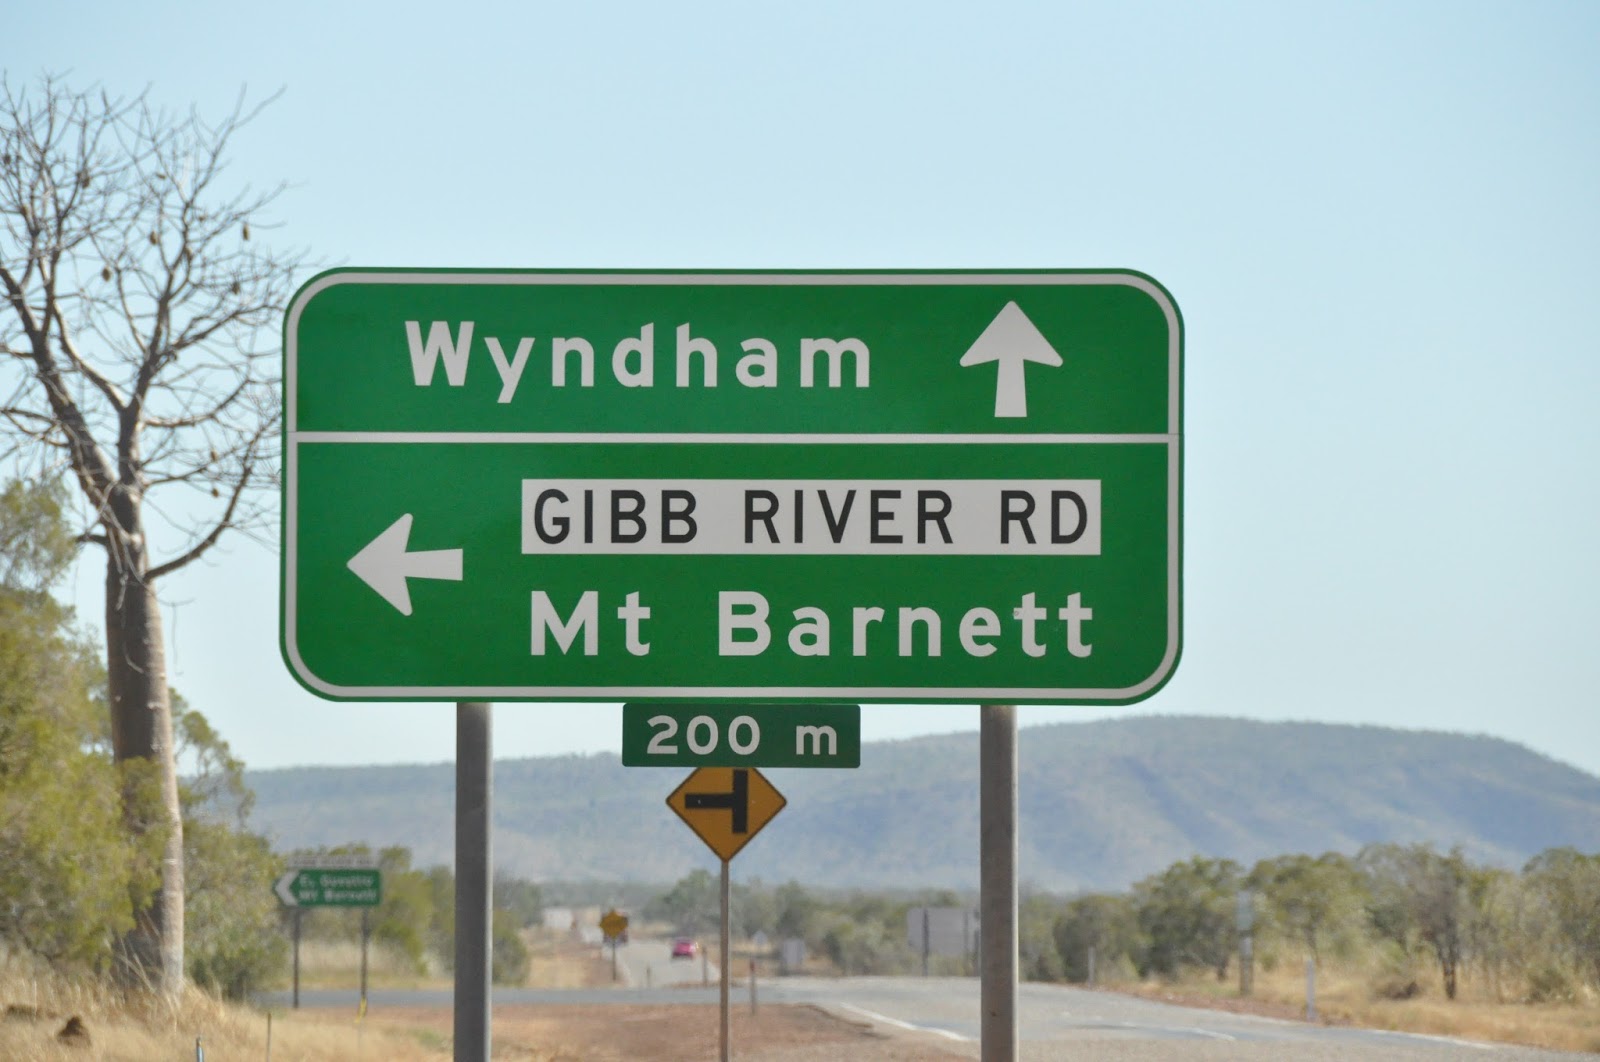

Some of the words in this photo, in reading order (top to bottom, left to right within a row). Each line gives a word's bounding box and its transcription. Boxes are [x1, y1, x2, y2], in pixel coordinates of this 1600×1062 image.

[405, 320, 870, 404] Wyndham
[534, 488, 698, 545] GIBB
[744, 489, 954, 544] RIVER
[1000, 489, 1088, 545] RD
[530, 590, 651, 657] Mt
[718, 590, 1093, 658] Barnett
[647, 715, 761, 756] 200
[796, 725, 837, 755] m
